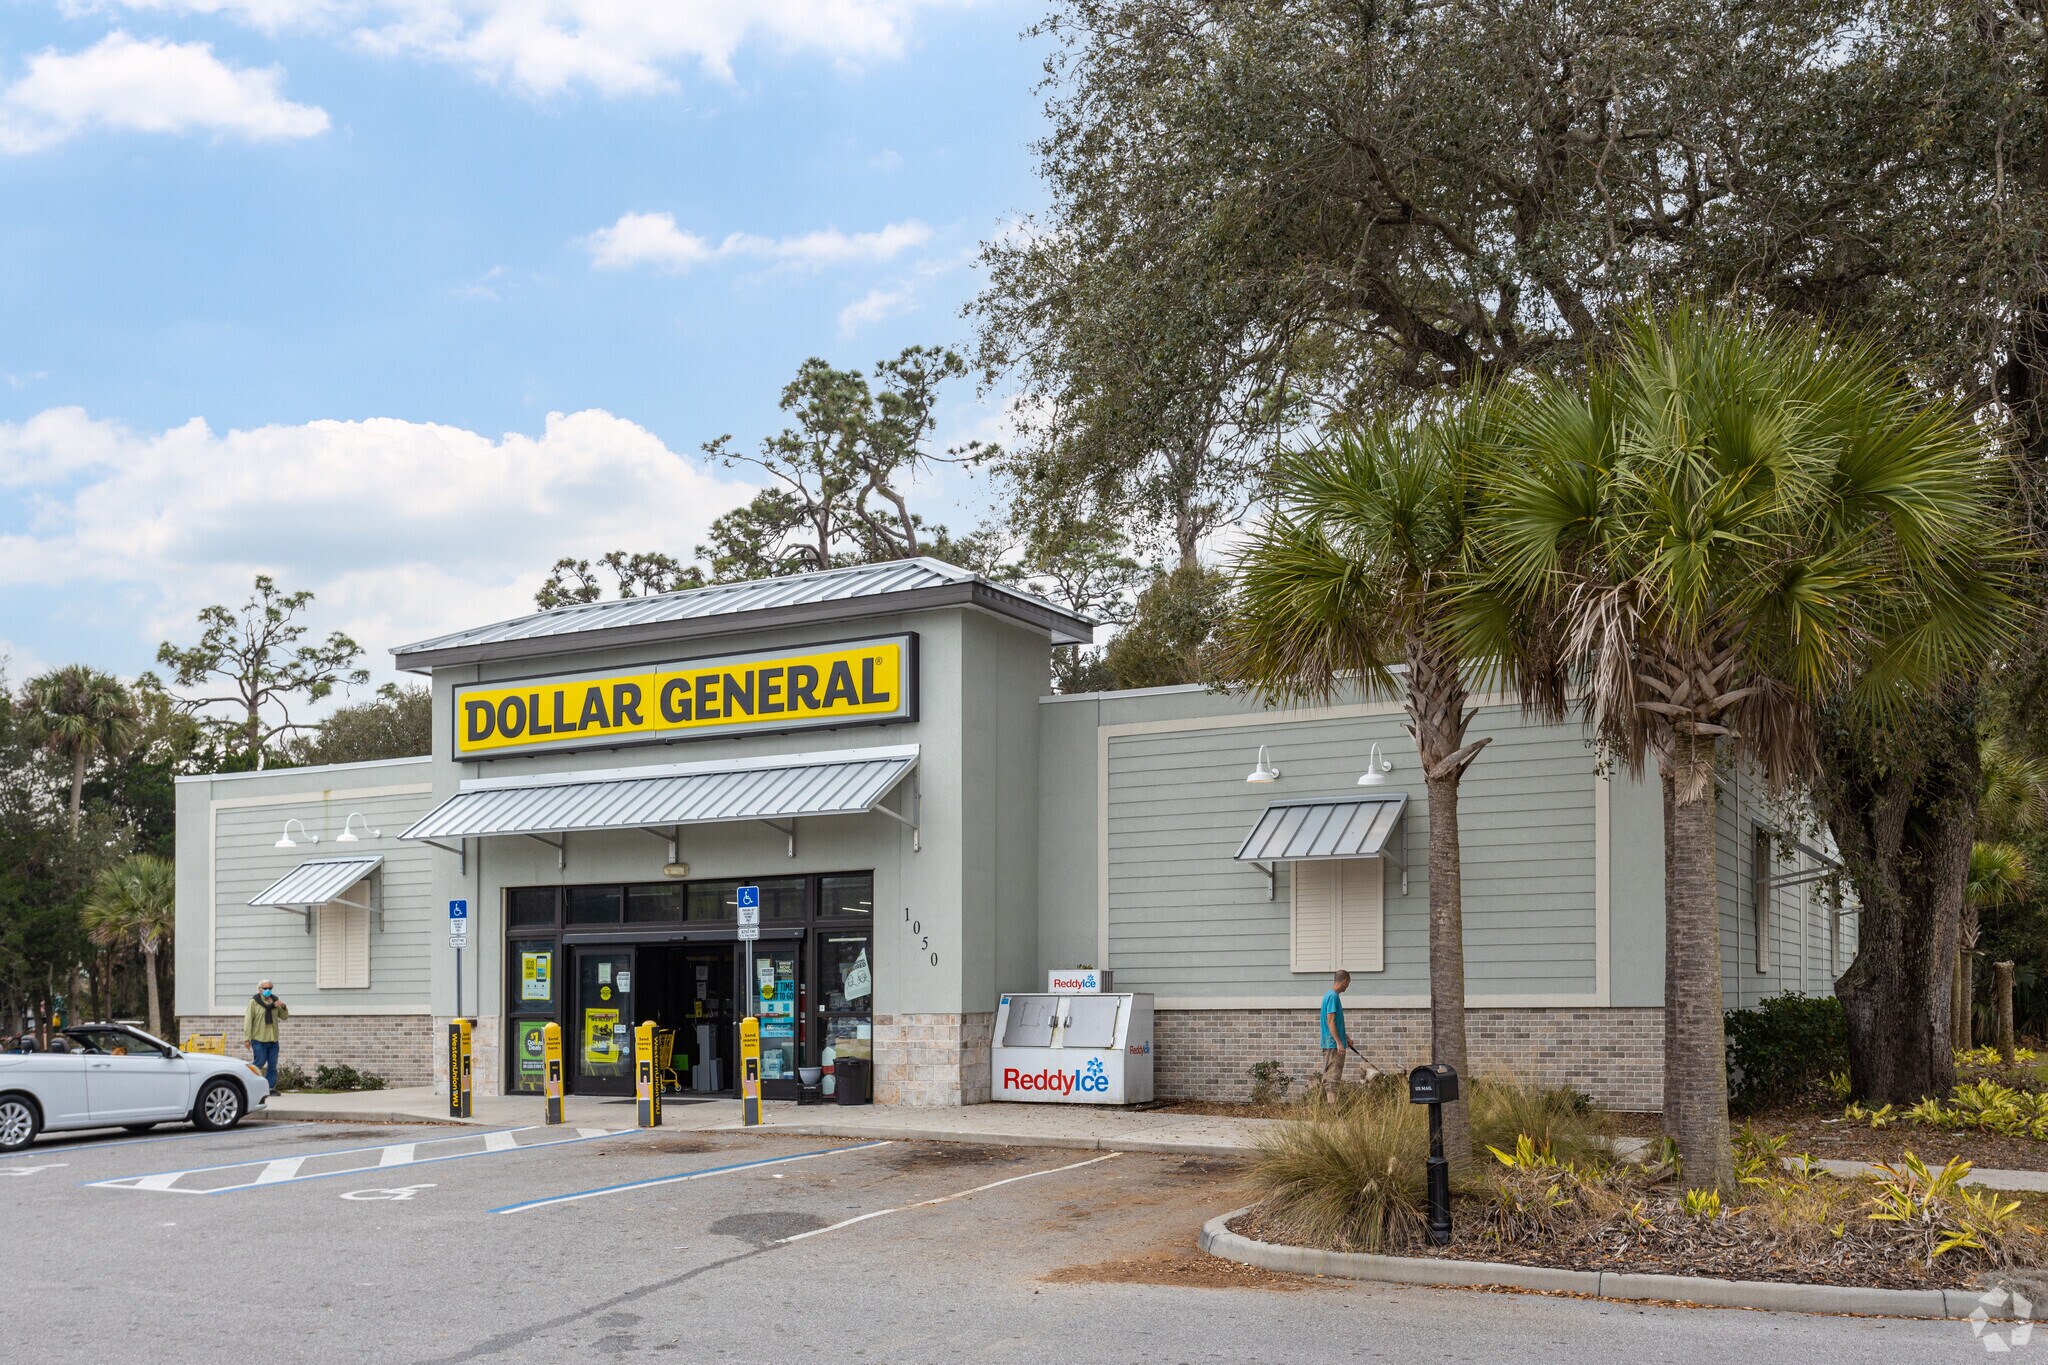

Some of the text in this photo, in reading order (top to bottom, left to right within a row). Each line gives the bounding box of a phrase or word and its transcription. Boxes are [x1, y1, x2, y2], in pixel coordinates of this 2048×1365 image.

[465, 656, 891, 742] DOLLAR GENERAL
[905, 907, 938, 967] 1050
[780, 981, 794, 990] TIME
[1054, 979, 1096, 991] ReddyIce
[786, 992, 794, 1000] GO
[1129, 1045, 1151, 1056] ReddyIce
[1004, 1068, 1109, 1096] ReddyIce
